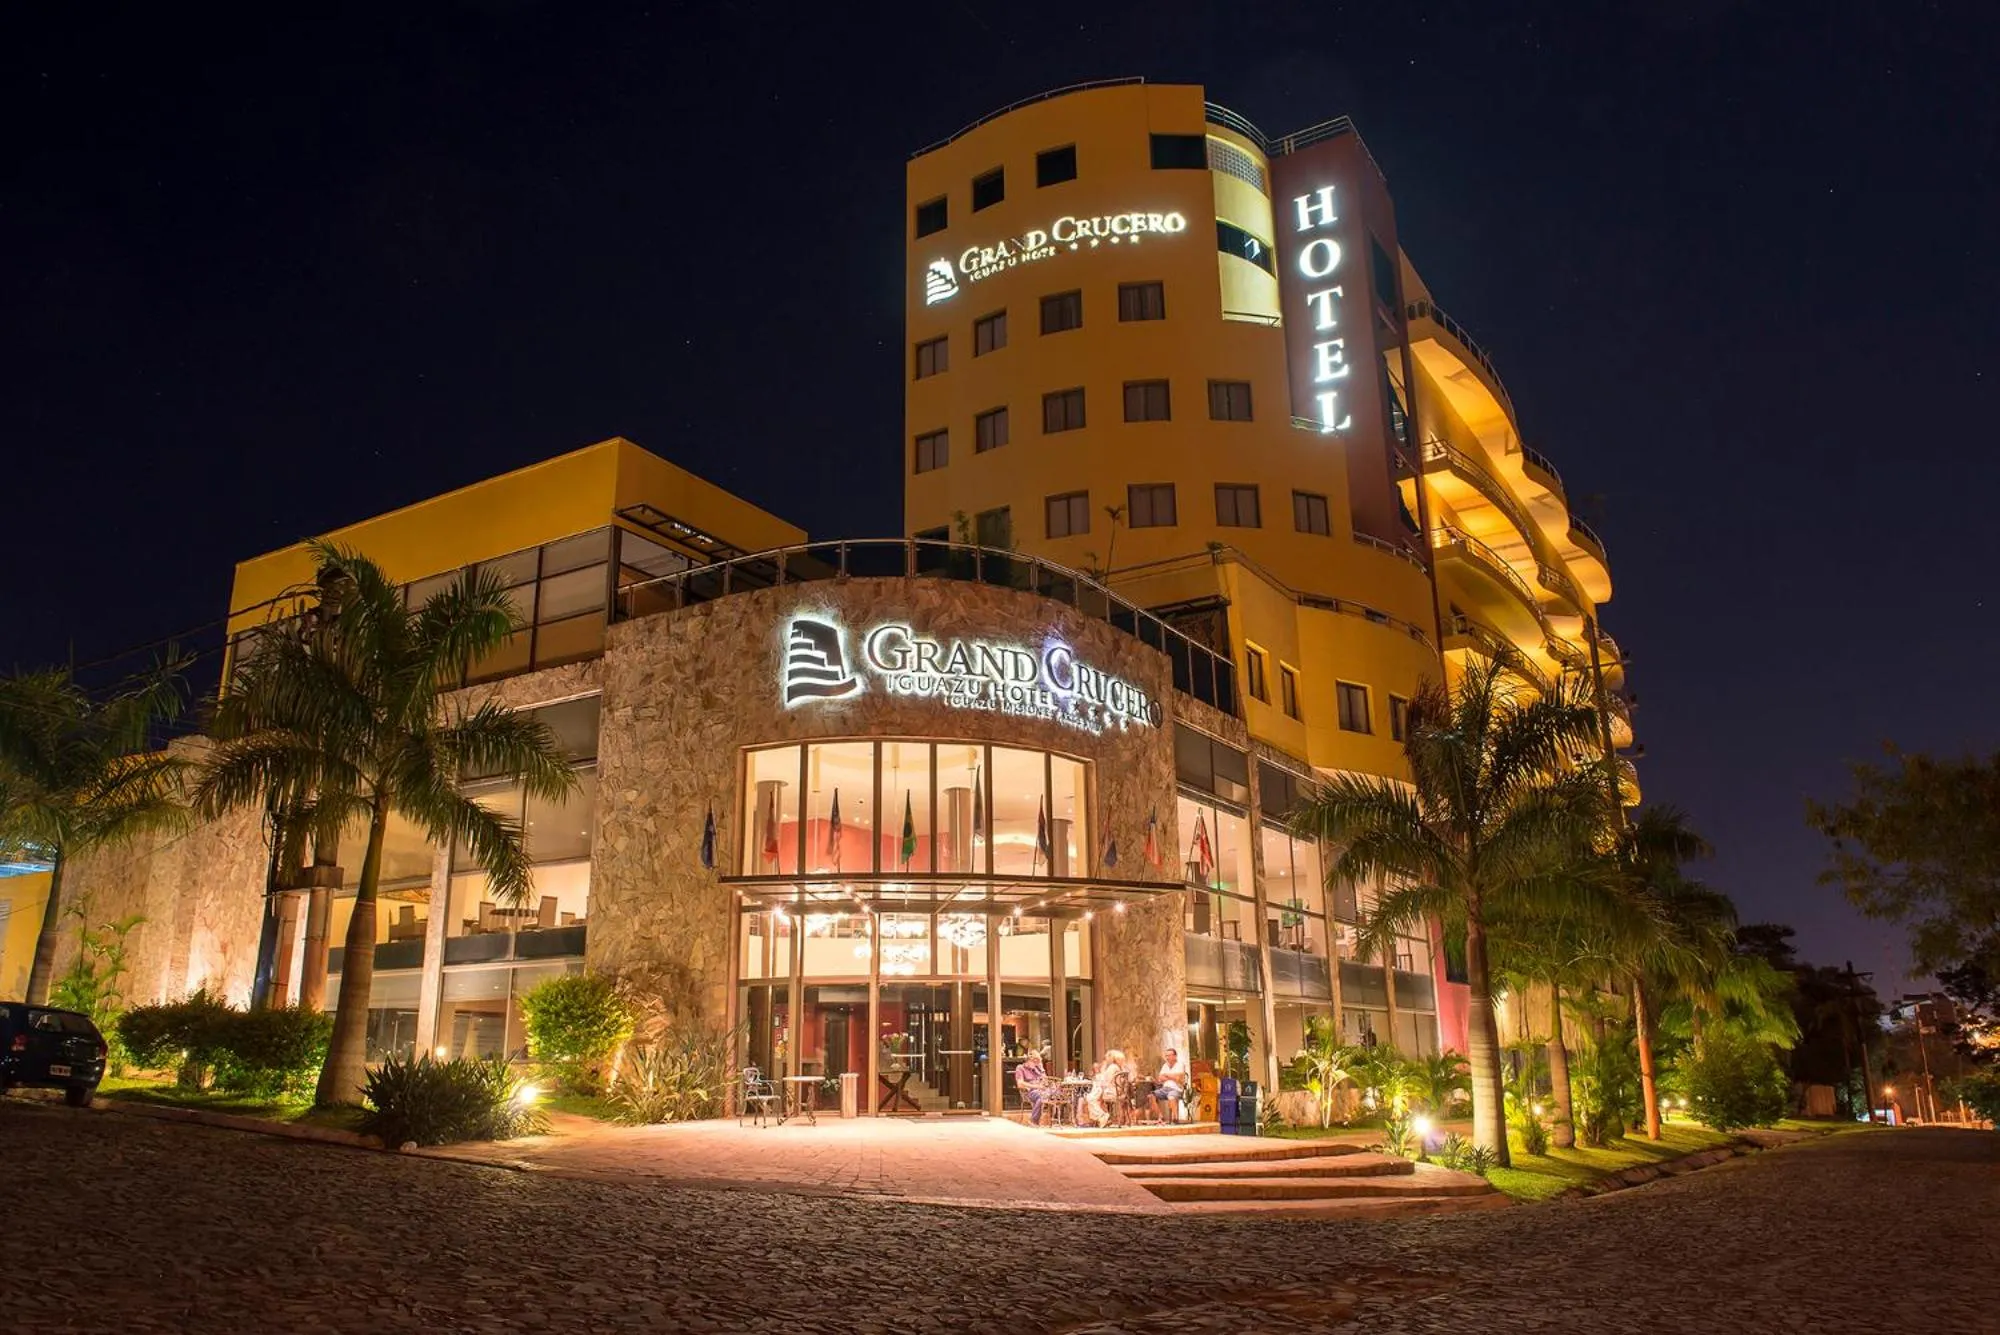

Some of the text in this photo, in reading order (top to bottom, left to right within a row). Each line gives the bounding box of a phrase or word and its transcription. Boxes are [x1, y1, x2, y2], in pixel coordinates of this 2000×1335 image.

[959, 212, 1187, 274] GRAND CRUCERO
[1293, 185, 1352, 434] HOTEL
[866, 624, 1163, 730] GRAND CRUCERO
[887, 672, 1060, 711] IGUAZU HOTEL
